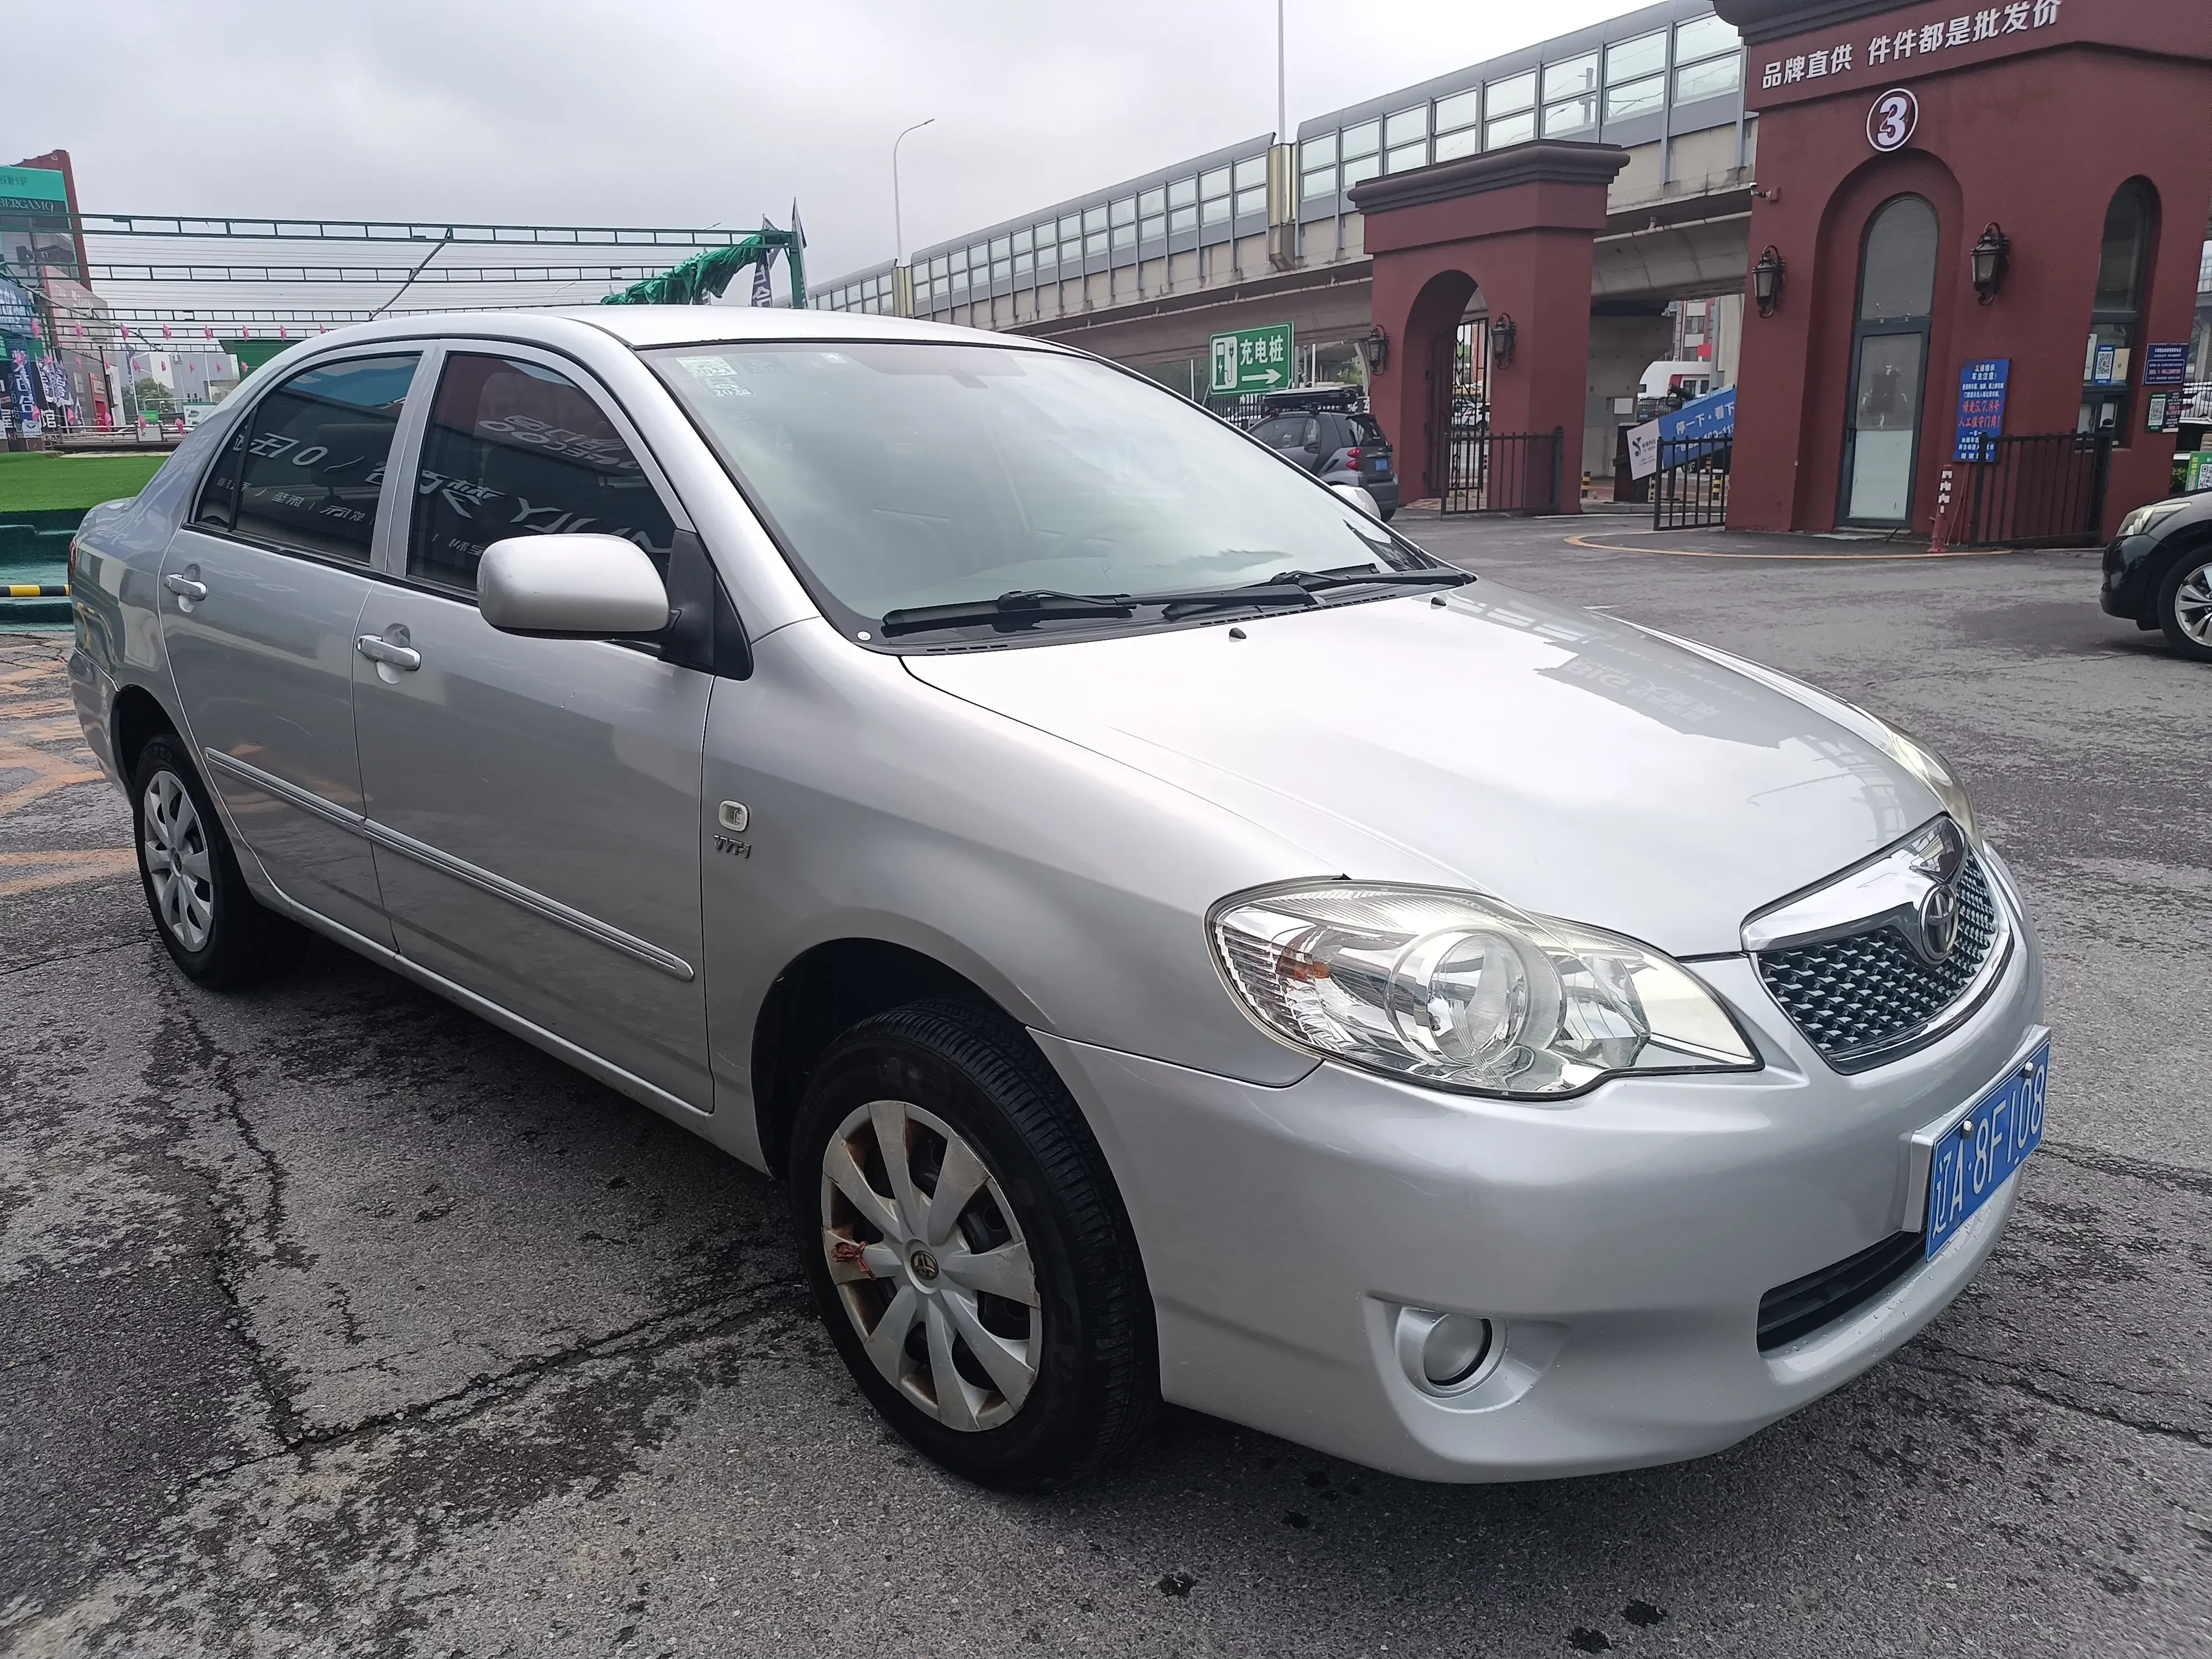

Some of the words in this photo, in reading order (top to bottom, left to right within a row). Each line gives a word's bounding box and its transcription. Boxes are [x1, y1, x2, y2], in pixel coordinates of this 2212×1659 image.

[1762, 43, 1854, 89] 品牌直供
[1867, 0, 2062, 66] 件件都是批发价
[1877, 96, 1907, 146] 3
[1240, 335, 1284, 366] 充电桩
